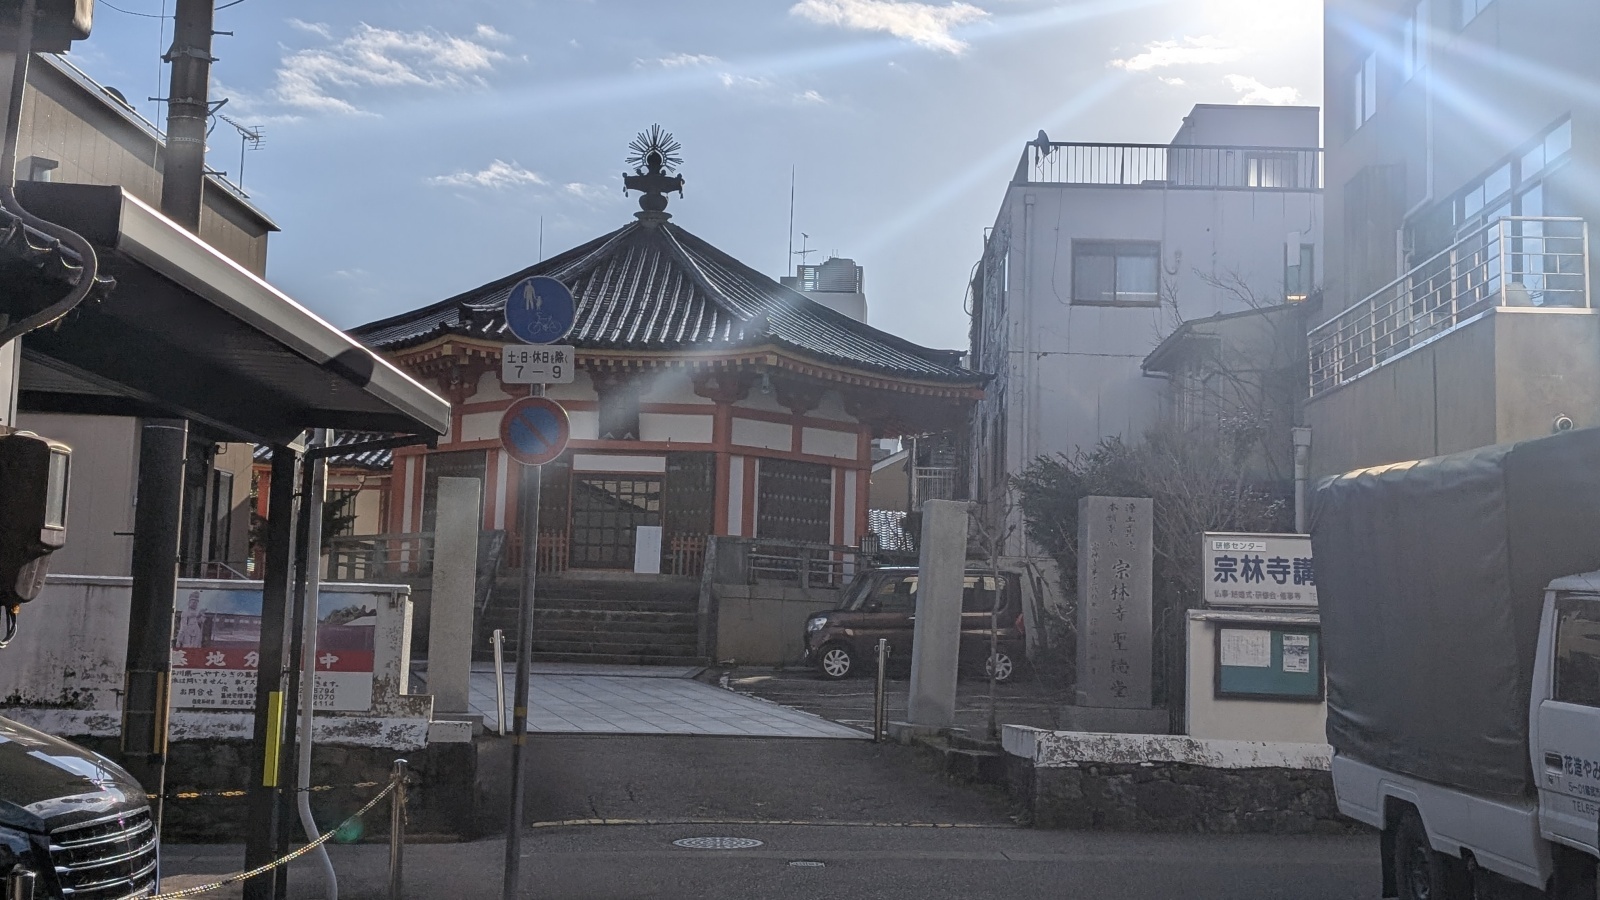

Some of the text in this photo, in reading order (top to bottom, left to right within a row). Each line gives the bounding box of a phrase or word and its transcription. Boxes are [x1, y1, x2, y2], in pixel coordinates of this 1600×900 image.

[1215, 541, 1263, 550] 研修センター
